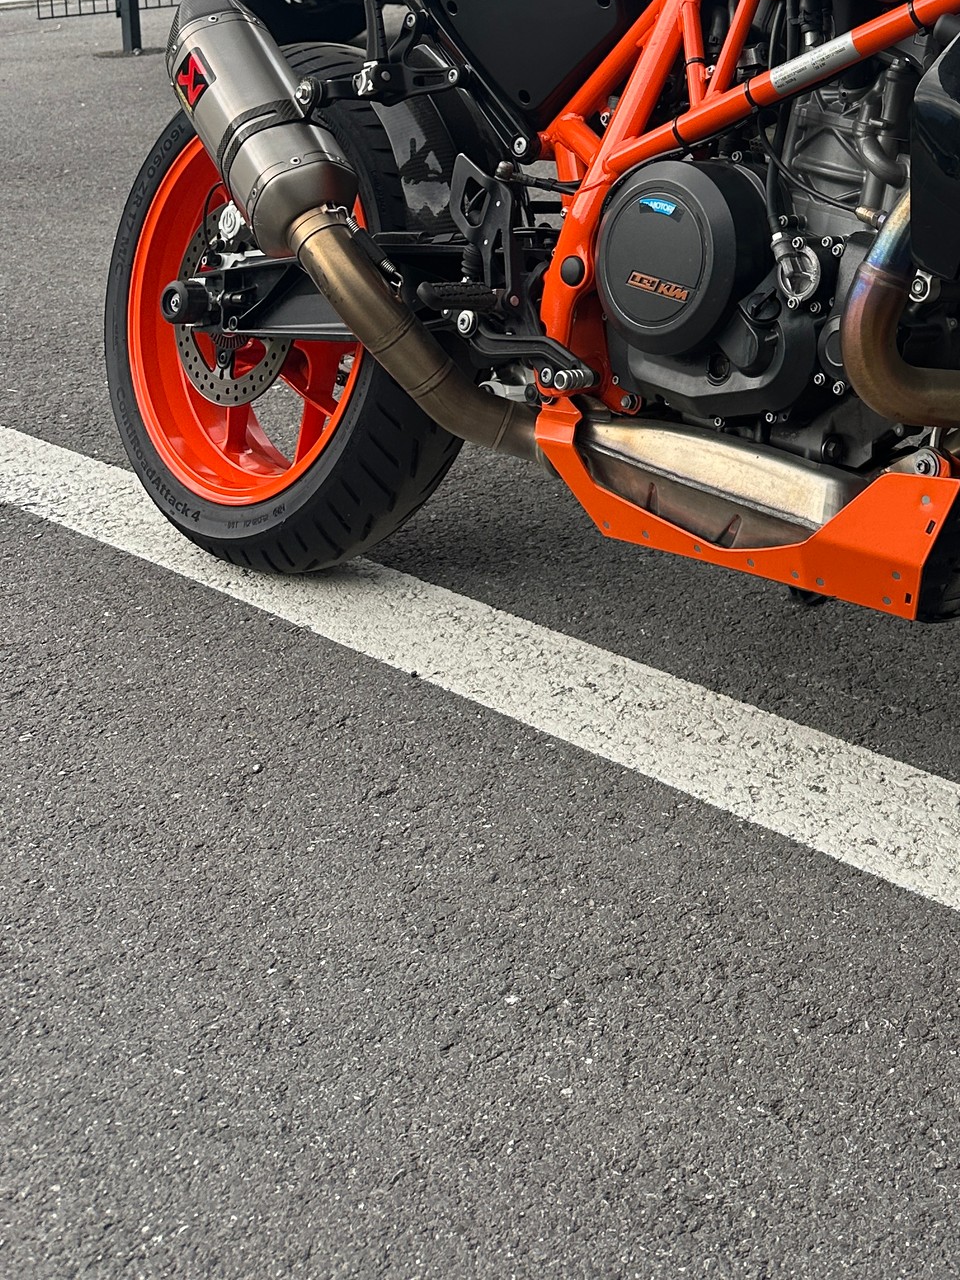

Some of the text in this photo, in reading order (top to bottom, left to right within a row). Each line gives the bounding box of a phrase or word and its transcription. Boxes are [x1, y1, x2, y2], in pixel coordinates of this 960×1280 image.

[148, 123, 185, 180] 160/60
[133, 181, 148, 208] ZR
[126, 212, 137, 234] 17
[658, 281, 690, 302] KTM
[116, 386, 202, 523] ContiRoadAttack 4
